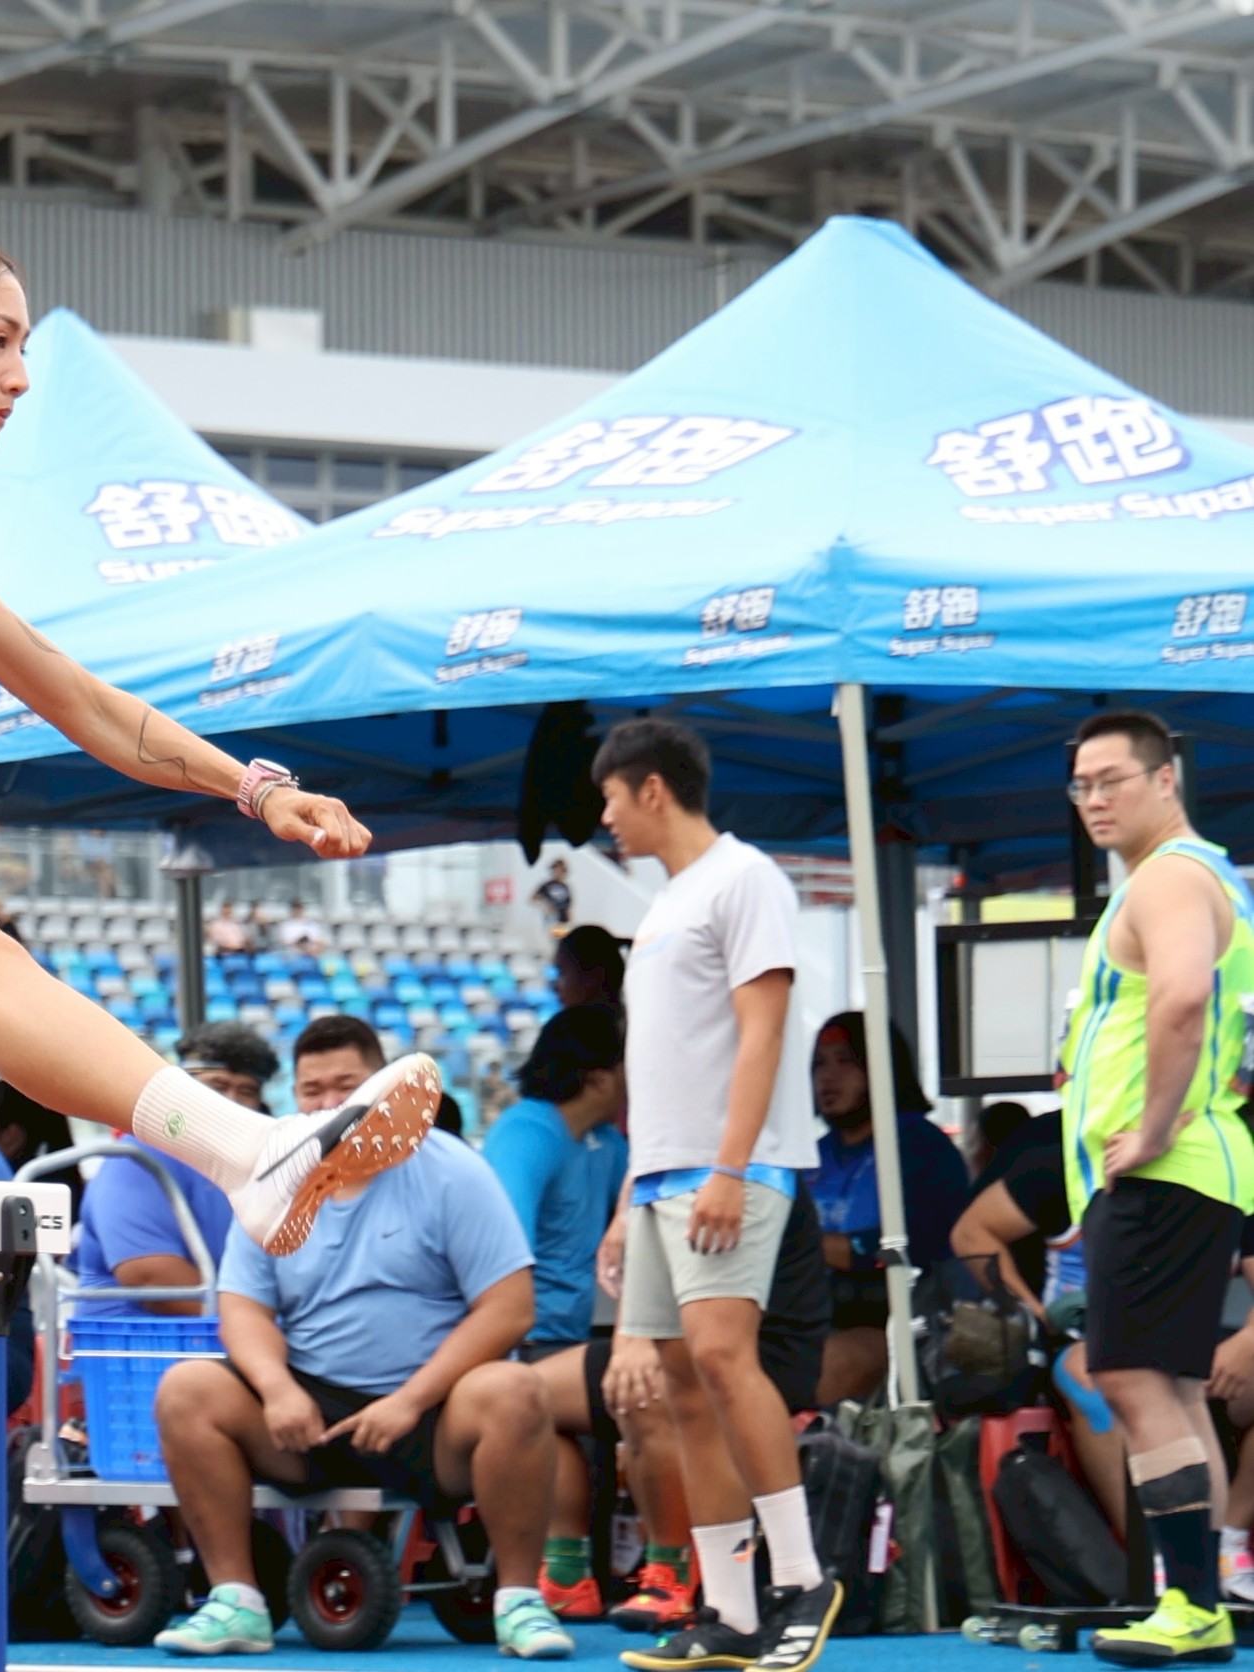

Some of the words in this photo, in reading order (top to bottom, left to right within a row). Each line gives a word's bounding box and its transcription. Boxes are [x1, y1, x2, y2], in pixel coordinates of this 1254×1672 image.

[464, 415, 800, 494] 舒跑
[926, 396, 1186, 498] 舒跑
[959, 503, 1115, 526] Super
[1118, 477, 1254, 521] Supa
